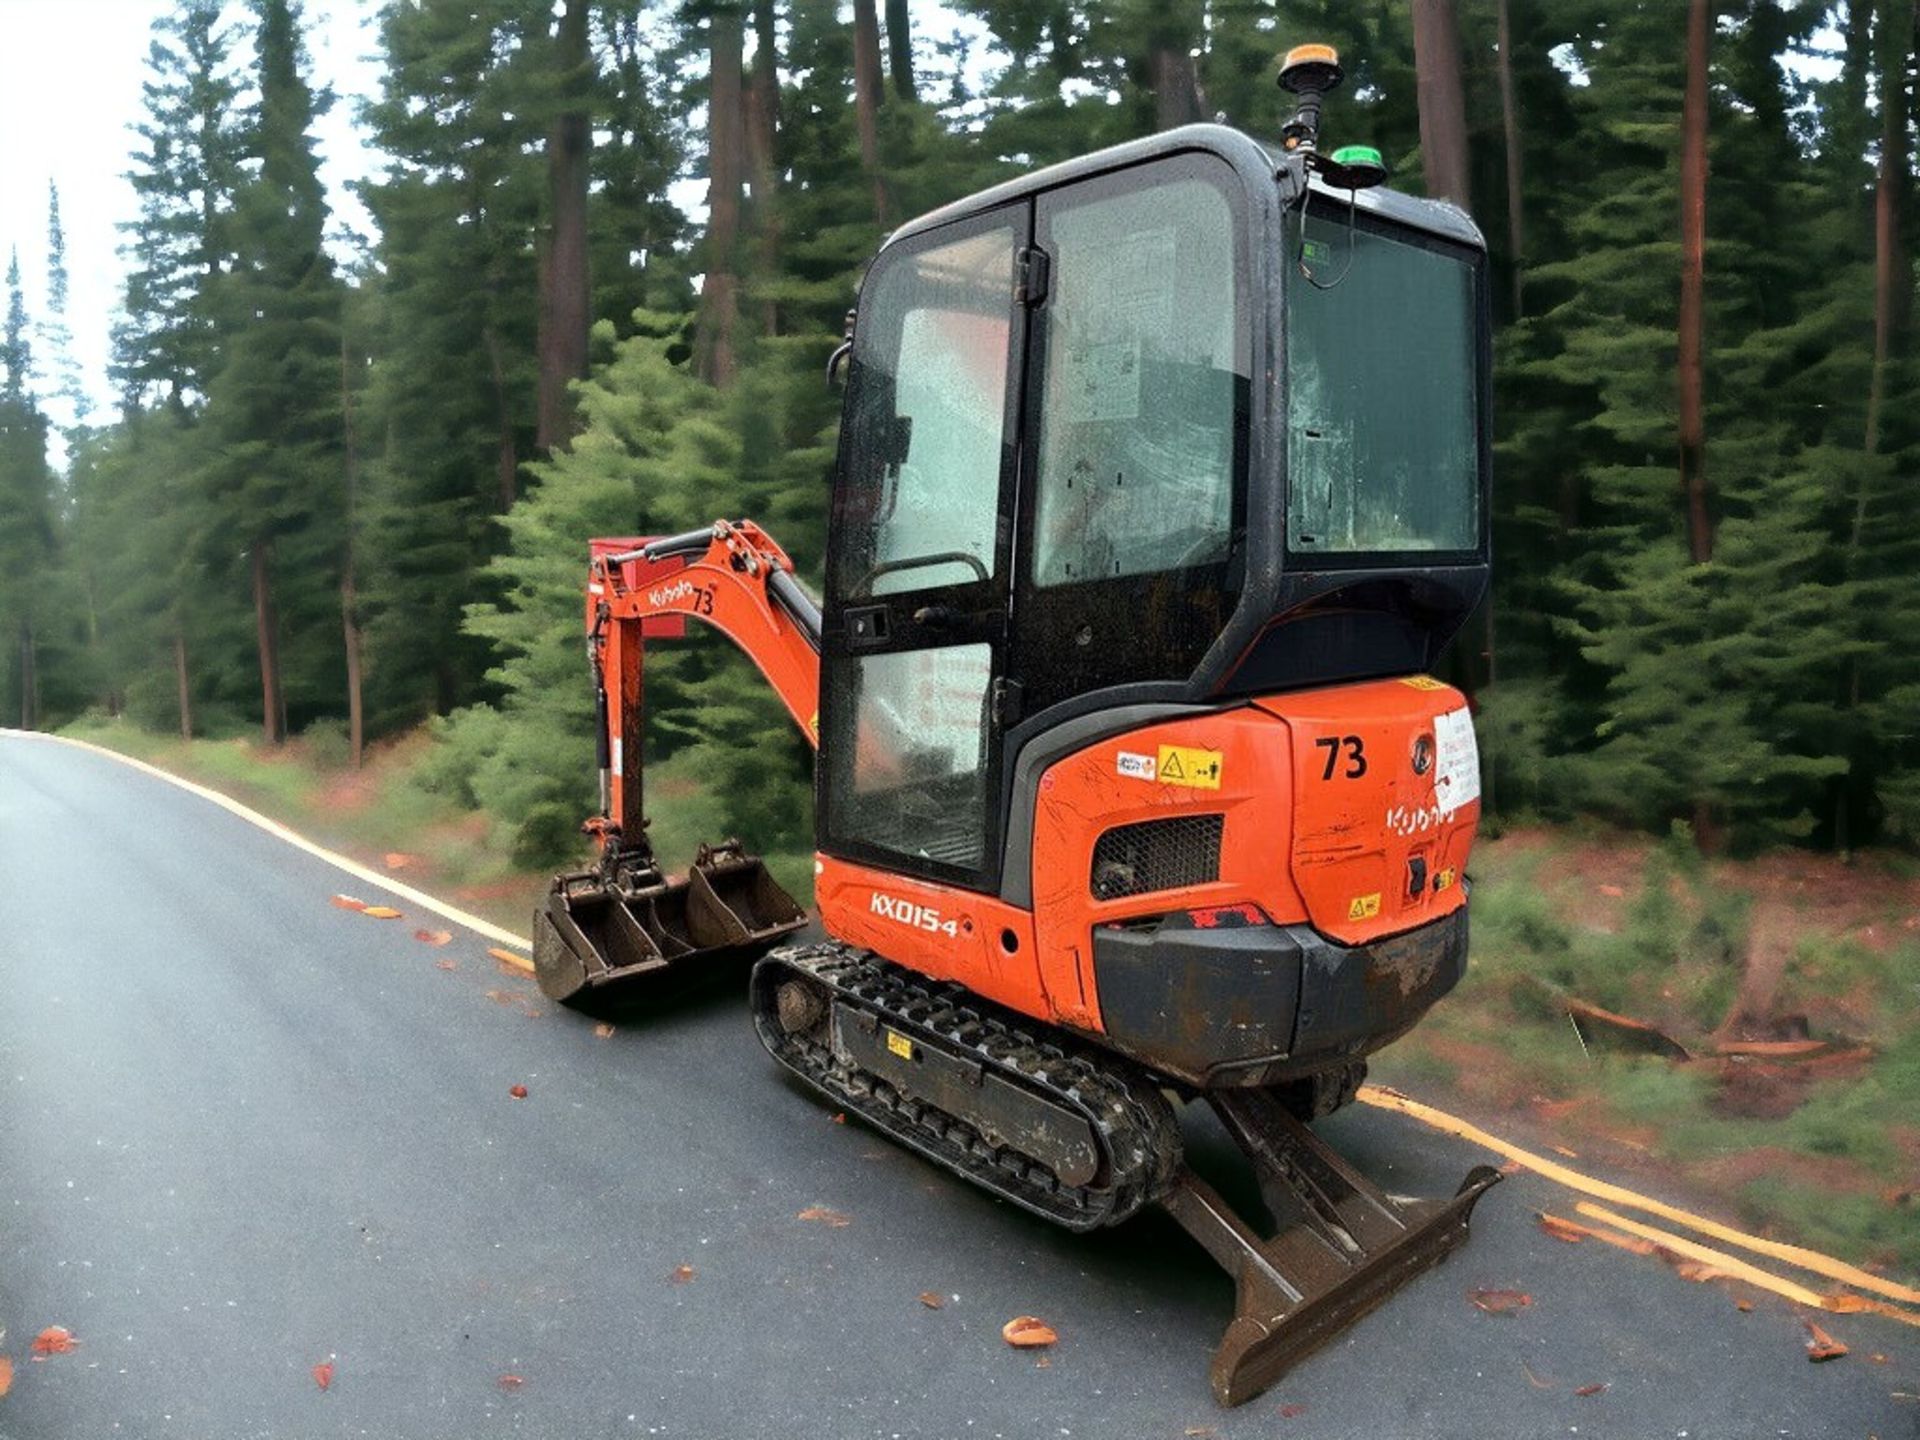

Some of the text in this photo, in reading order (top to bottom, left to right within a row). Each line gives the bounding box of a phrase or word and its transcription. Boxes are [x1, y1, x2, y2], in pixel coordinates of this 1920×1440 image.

[649, 579, 693, 607] Kubota
[694, 588, 713, 615] 73
[1315, 735, 1367, 780] 73
[870, 892, 957, 938] KX015-4
